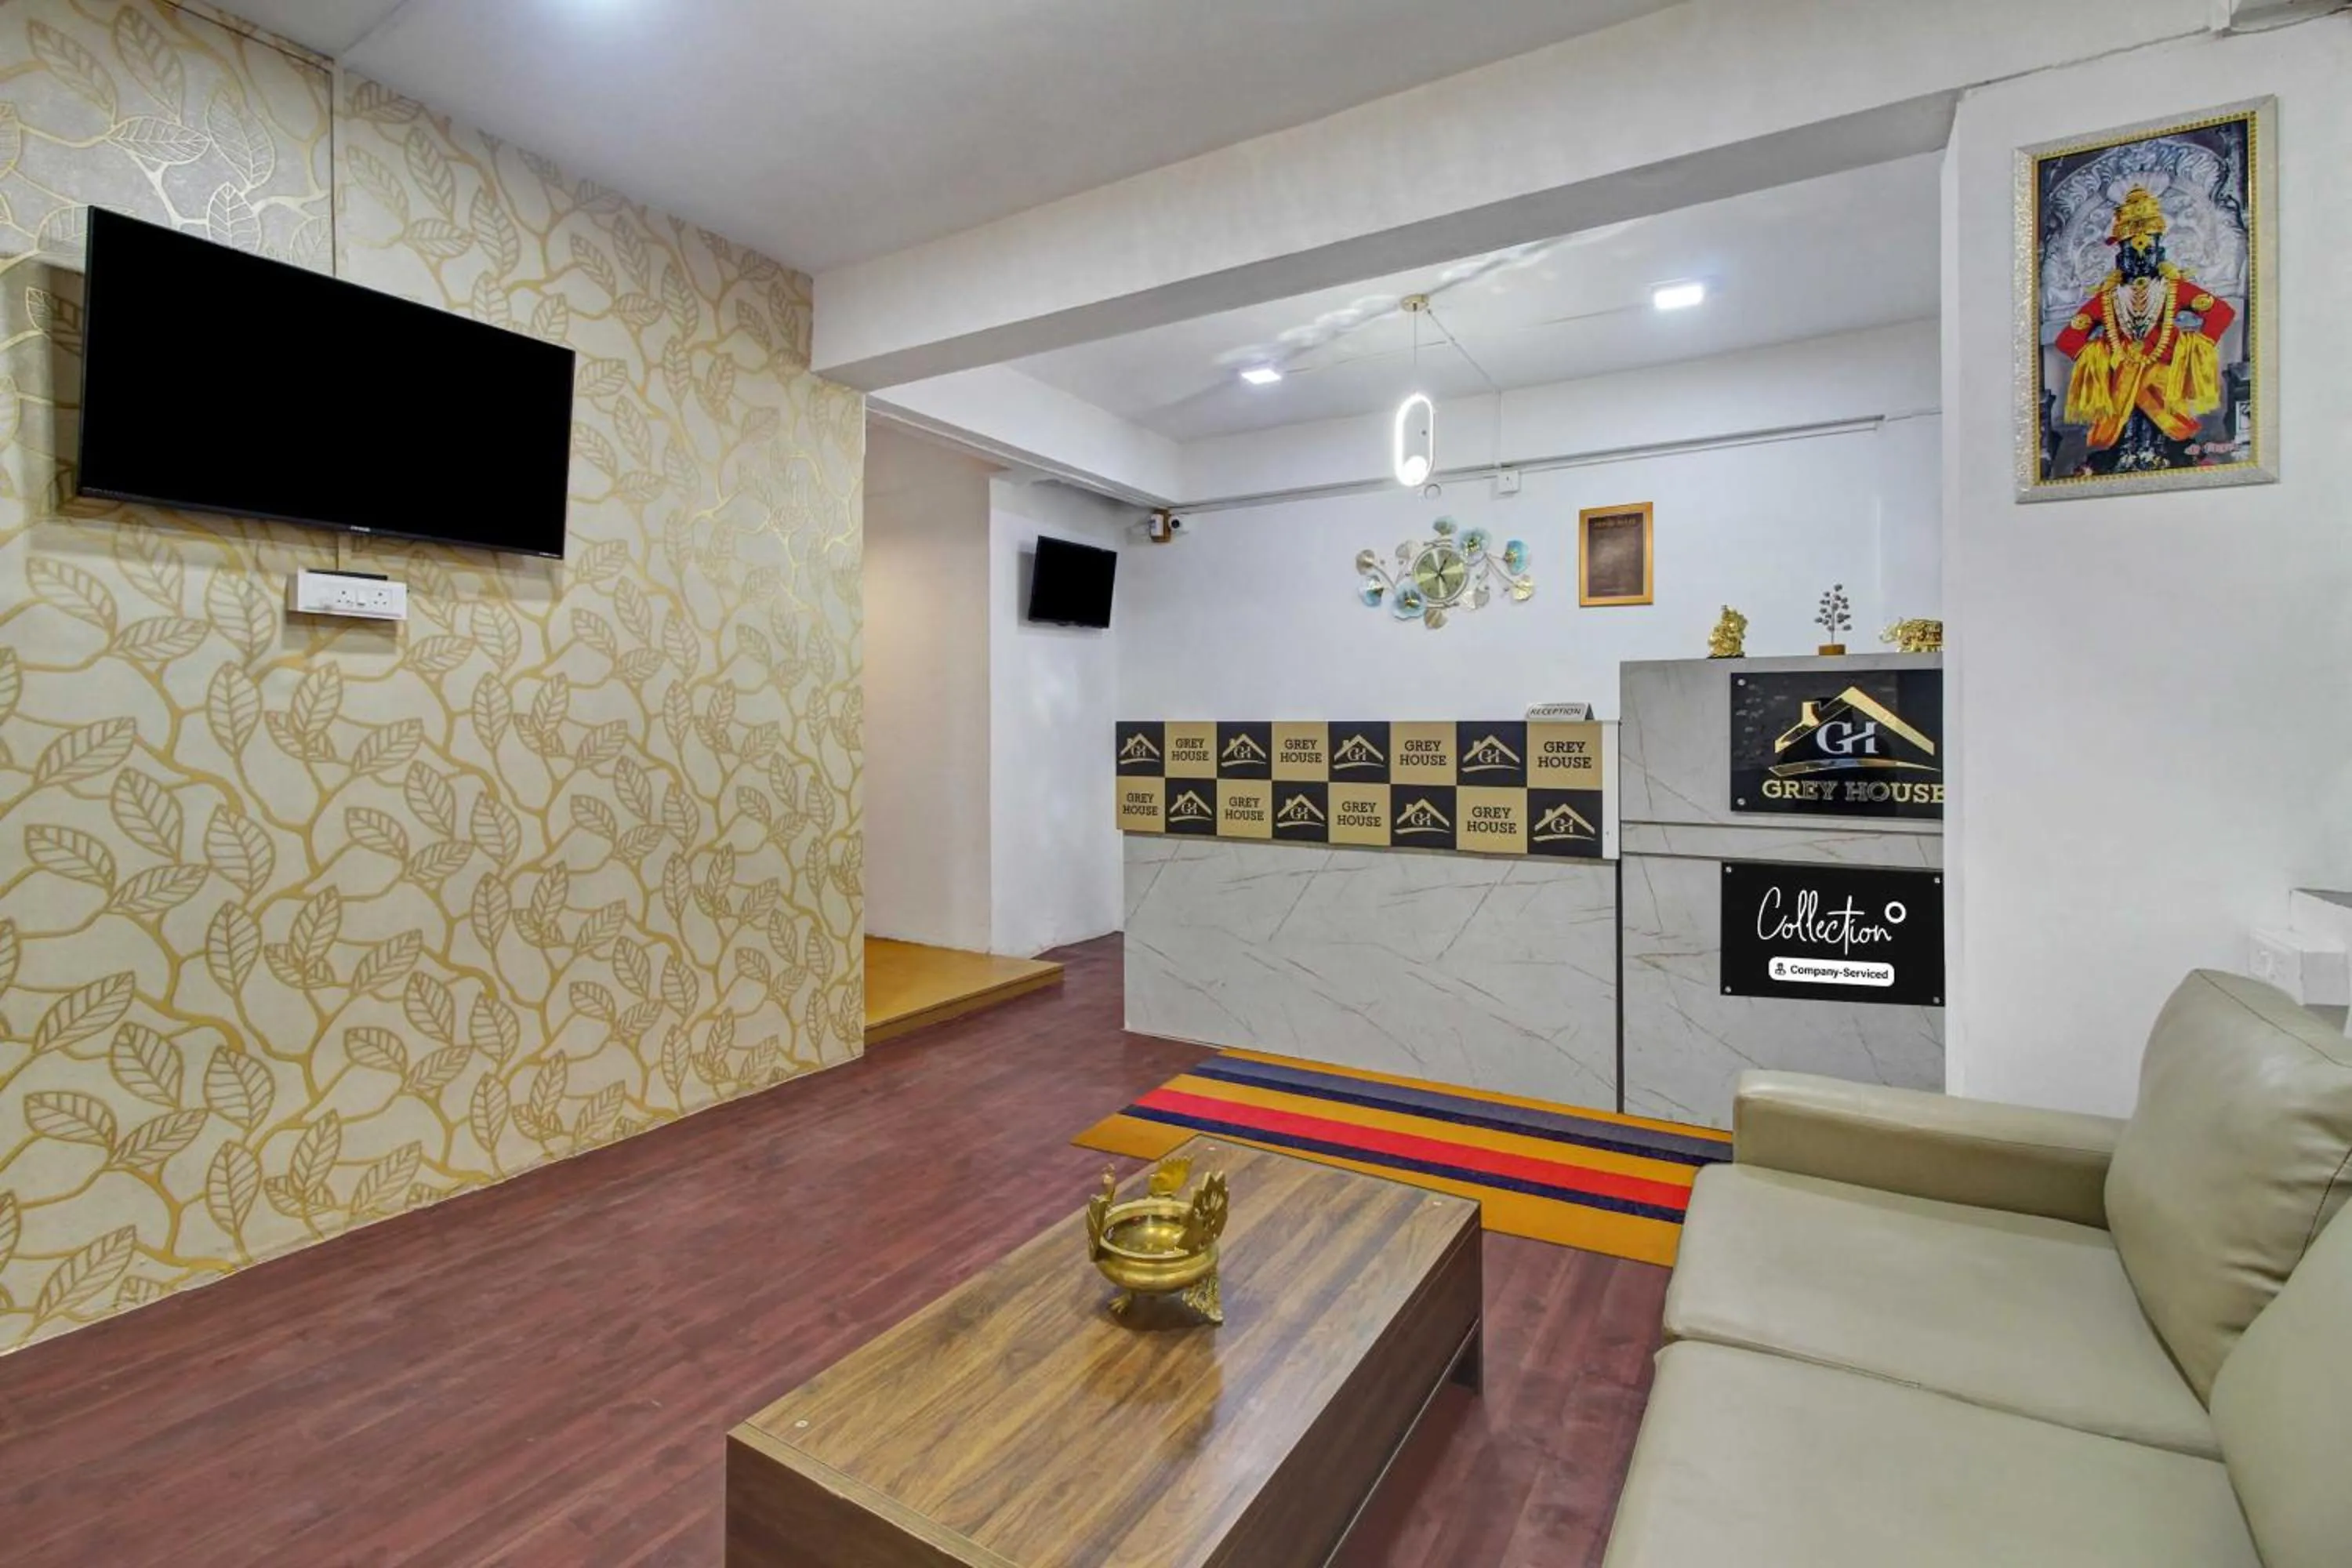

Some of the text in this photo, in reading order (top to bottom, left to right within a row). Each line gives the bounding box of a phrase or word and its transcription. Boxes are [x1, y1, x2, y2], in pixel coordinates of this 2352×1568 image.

[1530, 707, 1581, 716] RECEPTION
[1175, 738, 1206, 749] GREY
[1283, 739, 1318, 750] GREY
[1404, 739, 1442, 752] GREY
[1543, 741, 1586, 753] GREY
[1171, 750, 1209, 761] HOUSE
[1279, 751, 1323, 763] HOUSE
[1399, 753, 1447, 766] HOUSE
[1537, 757, 1592, 769] HOUSE
[1762, 779, 1944, 804] GREY HOUSE
[1126, 793, 1154, 804] GREY
[1229, 796, 1261, 808] GREY
[1122, 804, 1159, 816] HOUSE
[1341, 800, 1377, 813] GREY
[1472, 805, 1512, 819] GREY
[1224, 808, 1265, 821] HOUSE
[1336, 815, 1382, 827] HOUSE
[1466, 821, 1517, 834] HOUSE
[1757, 886, 1893, 956] Collection
[1790, 964, 1889, 980] Company-Serviced
